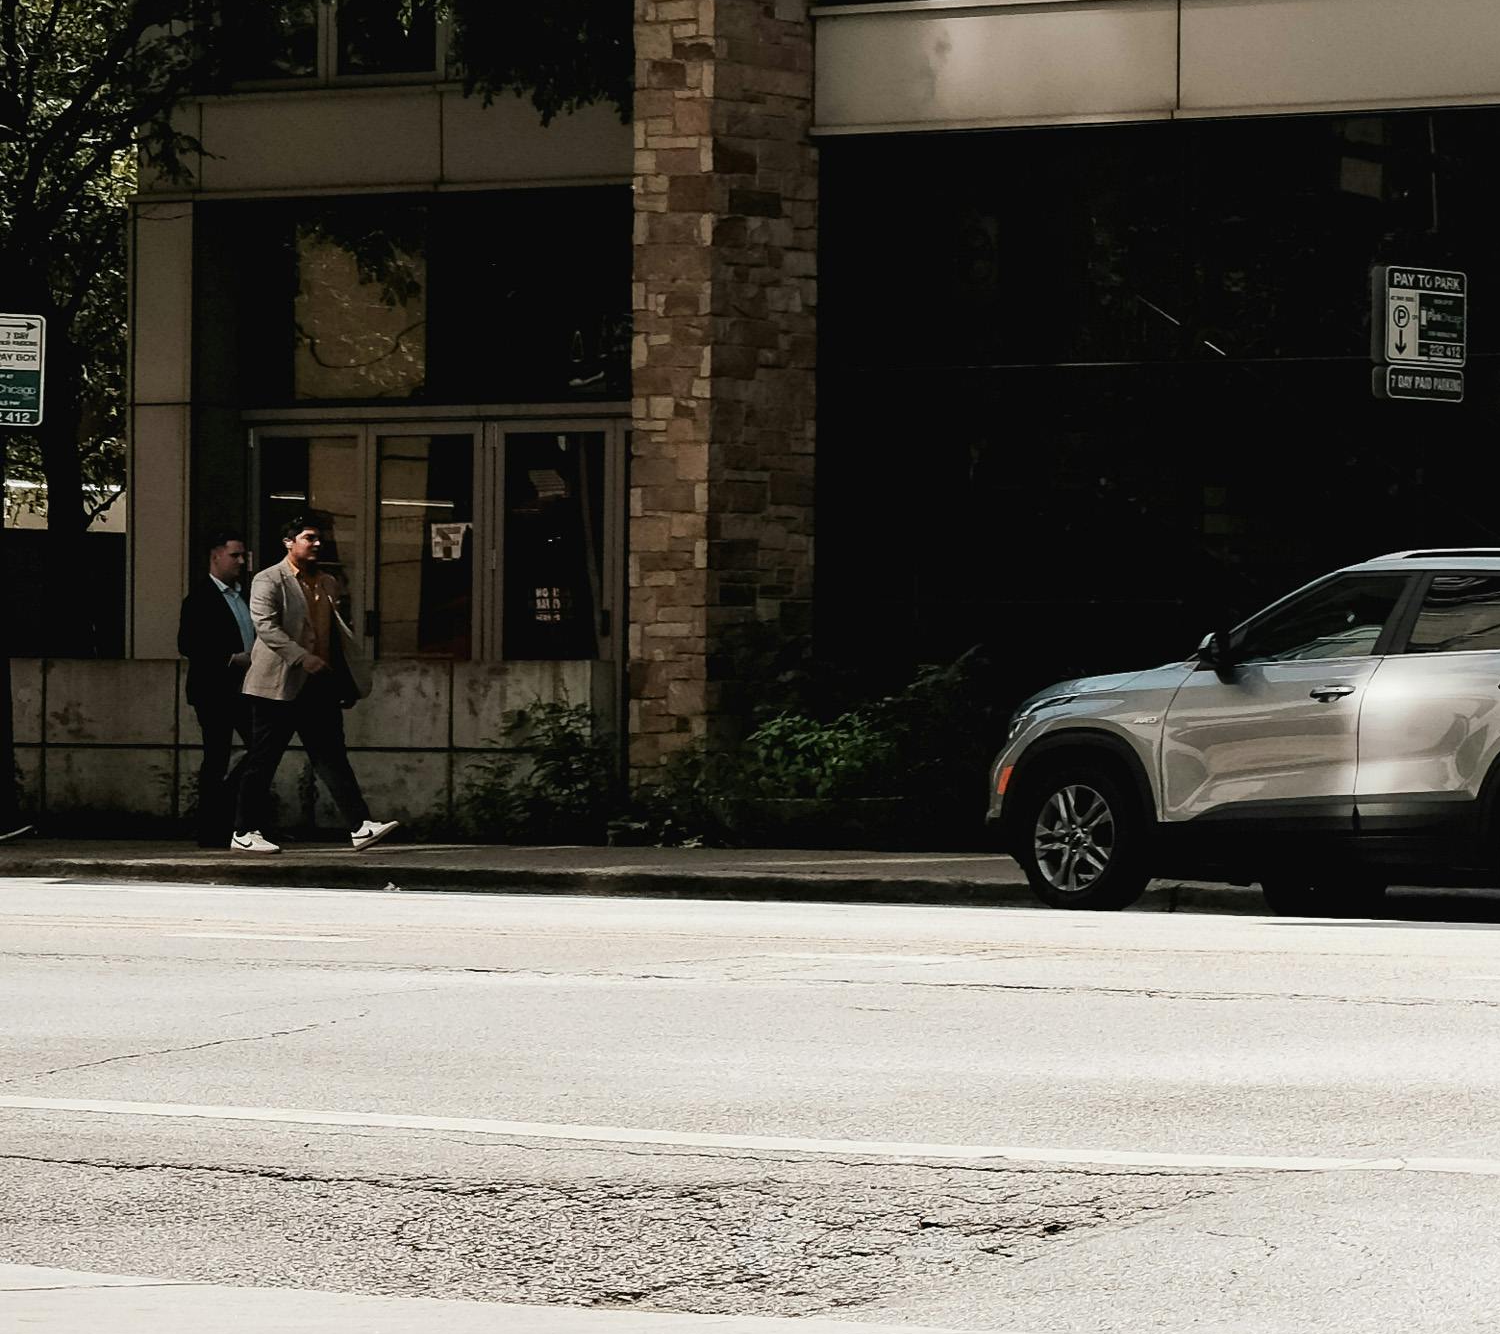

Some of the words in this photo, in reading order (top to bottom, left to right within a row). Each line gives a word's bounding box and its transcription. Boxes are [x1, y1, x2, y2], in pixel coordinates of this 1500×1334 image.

[1393, 272, 1414, 287] PAY
[1417, 274, 1432, 288] TO
[1434, 276, 1461, 290] PARK
[0, 353, 13, 362] AY
[1398, 375, 1413, 388] DAY
[1415, 376, 1432, 389] PAID
[5, 412, 30, 423] 412
